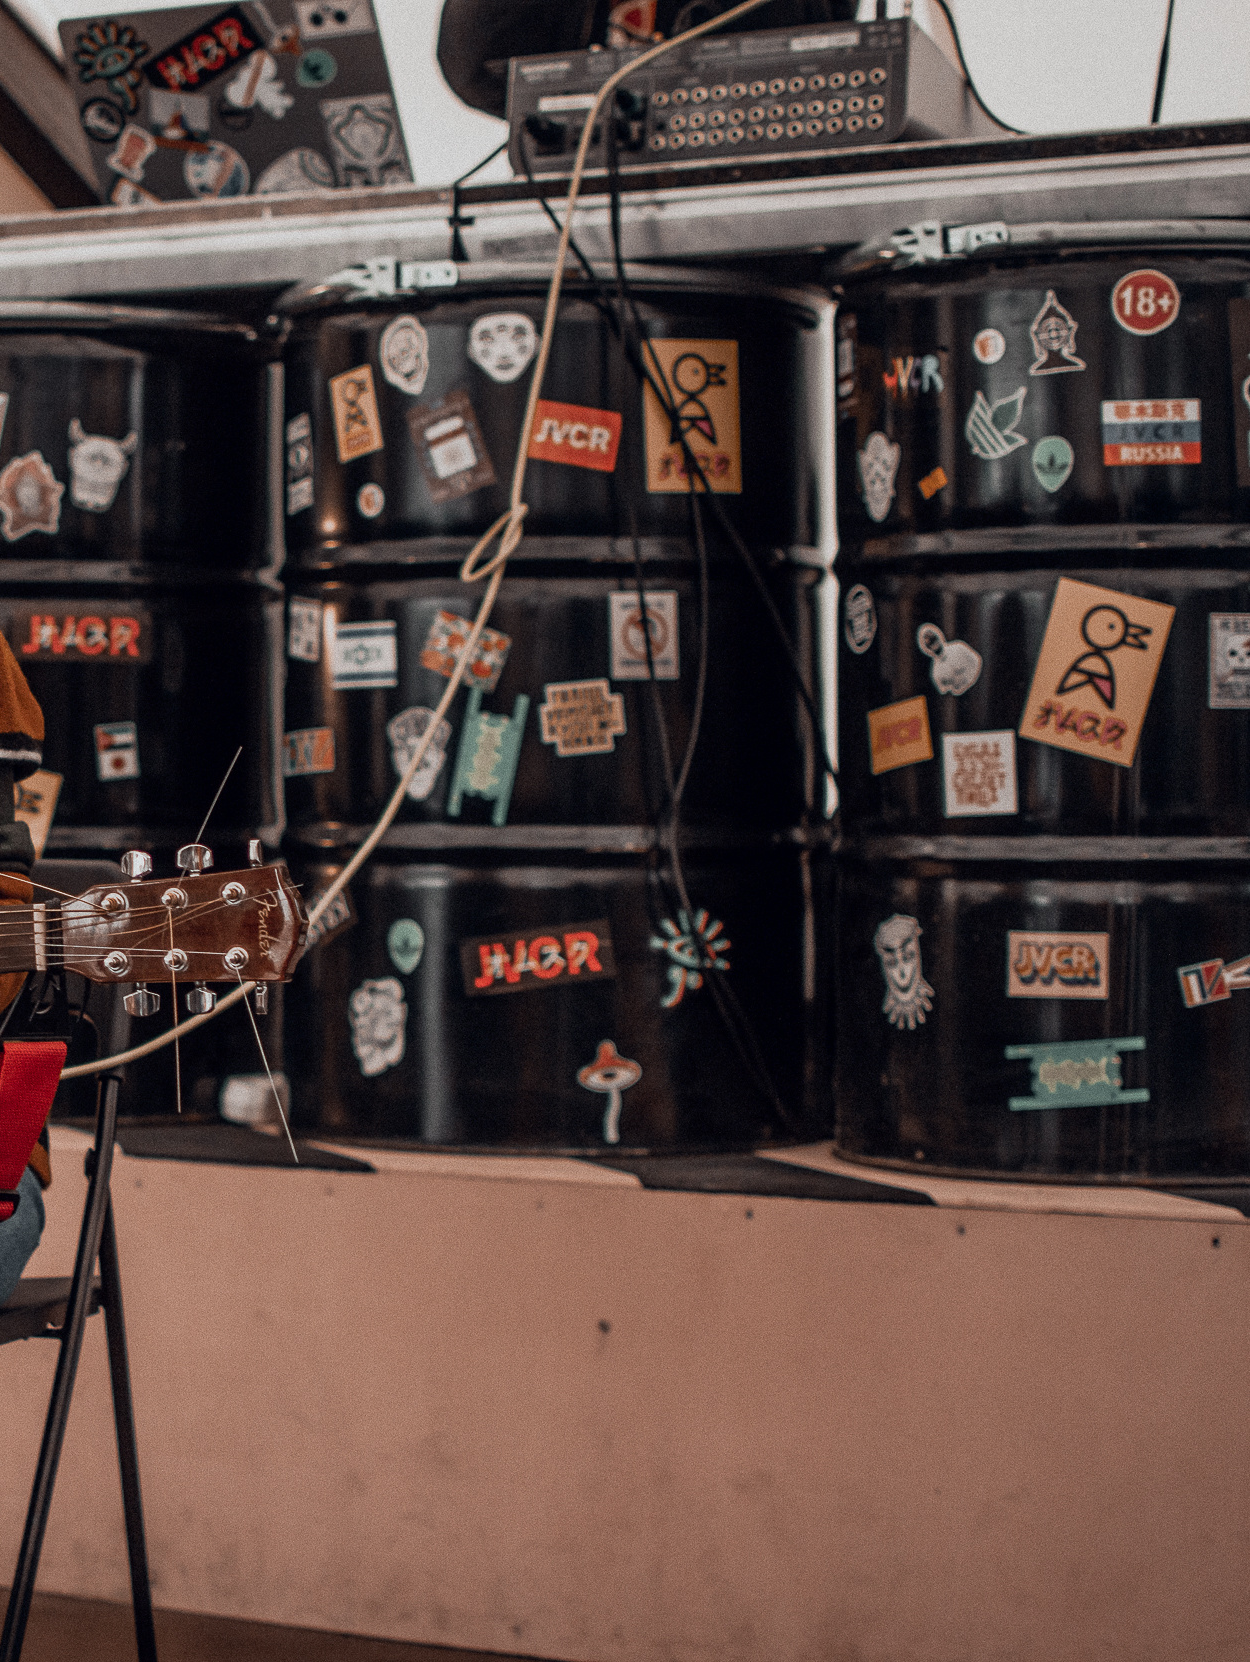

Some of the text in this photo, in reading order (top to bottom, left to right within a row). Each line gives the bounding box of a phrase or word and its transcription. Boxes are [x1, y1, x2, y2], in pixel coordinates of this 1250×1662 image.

[1120, 285, 1174, 318] 18+
[534, 417, 611, 455] JVCR
[1119, 445, 1184, 463] RUSSIA
[252, 887, 279, 958] Fender
[1014, 941, 1101, 987] JVCR
